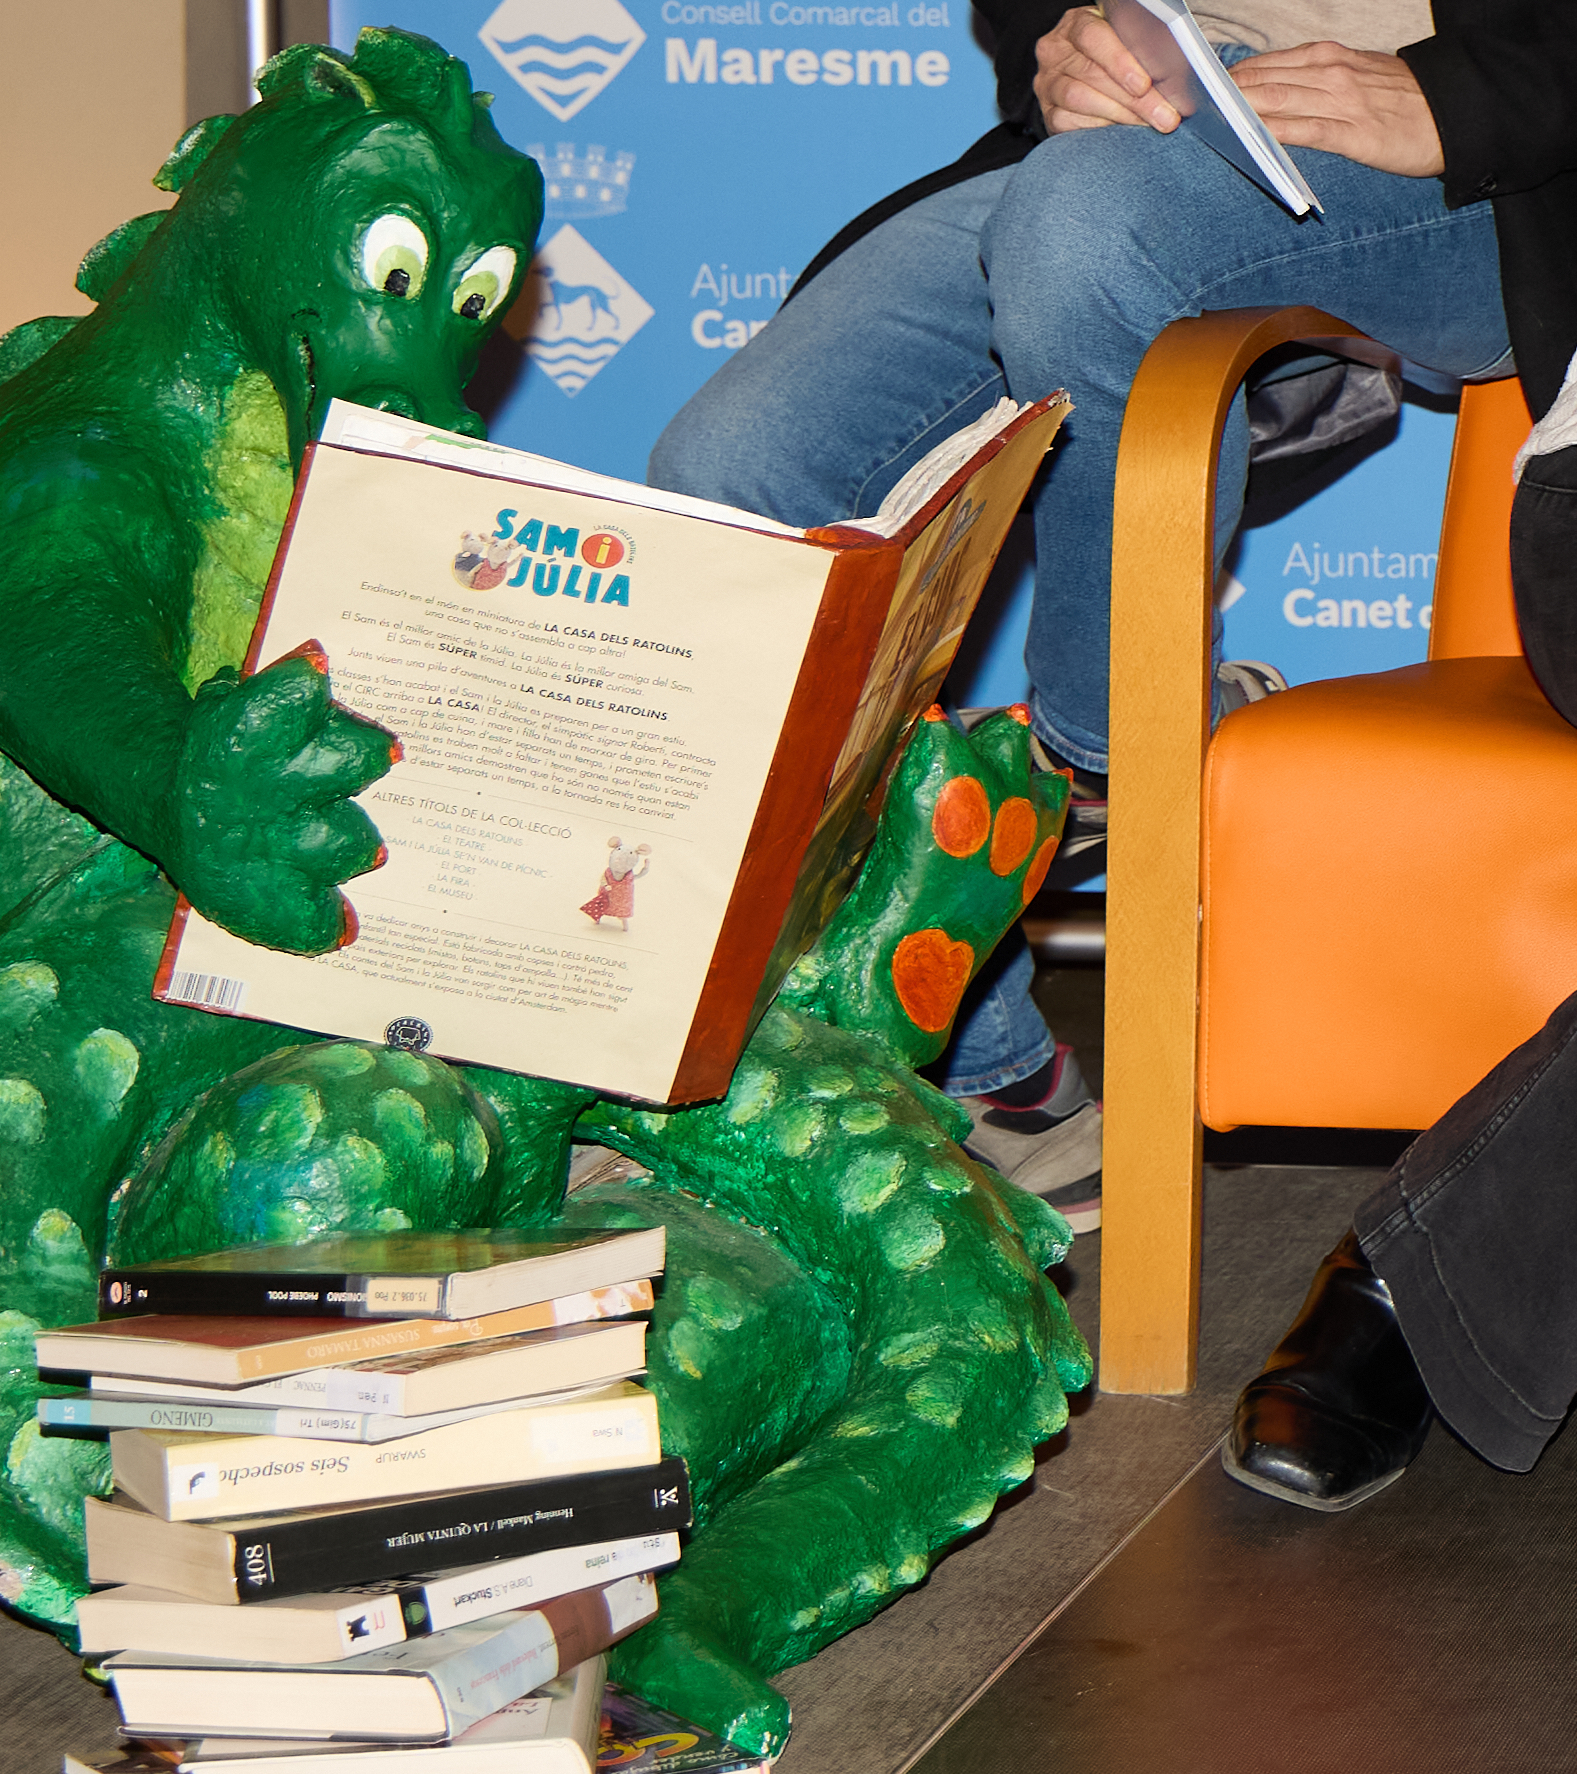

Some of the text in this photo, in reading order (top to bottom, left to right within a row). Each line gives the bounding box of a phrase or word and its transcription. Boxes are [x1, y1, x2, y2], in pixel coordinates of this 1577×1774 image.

[660, 0, 951, 28] Consell Comarcal del
[665, 37, 951, 87] Maresme
[690, 262, 793, 307] Ajunt
[491, 508, 580, 558] SAM
[1282, 541, 1438, 585] Ajuntam
[506, 554, 630, 608] JÚLIA
[1283, 587, 1413, 629] Canet
[544, 623, 558, 632] LA
[563, 627, 596, 640] CASA
[601, 633, 629, 645] DELS
[633, 638, 694, 660] RATOLINS,
[438, 641, 477, 659] SÚPER
[565, 673, 603, 688] SÚPER
[520, 684, 534, 695] LA
[539, 688, 571, 703] CASA
[576, 697, 604, 709] DELS
[608, 702, 670, 721] RATOLINS.
[372, 791, 415, 807] ALTRES
[420, 797, 457, 815] TÍTOLS
[461, 807, 478, 819] DE
[481, 811, 495, 823] LA
[307, 1335, 359, 1359] TAMARO
[362, 1328, 421, 1352] SUSANNA
[151, 1409, 213, 1427] GIMENO
[309, 1455, 350, 1475] Seis
[375, 1447, 426, 1464] SWARUP
[473, 1520, 488, 1533] LA
[497, 1512, 533, 1531] Mankell
[535, 1506, 573, 1523] Henning
[387, 1531, 425, 1549] MUJER
[426, 1521, 472, 1544] QUINTA
[245, 1543, 268, 1586] 408
